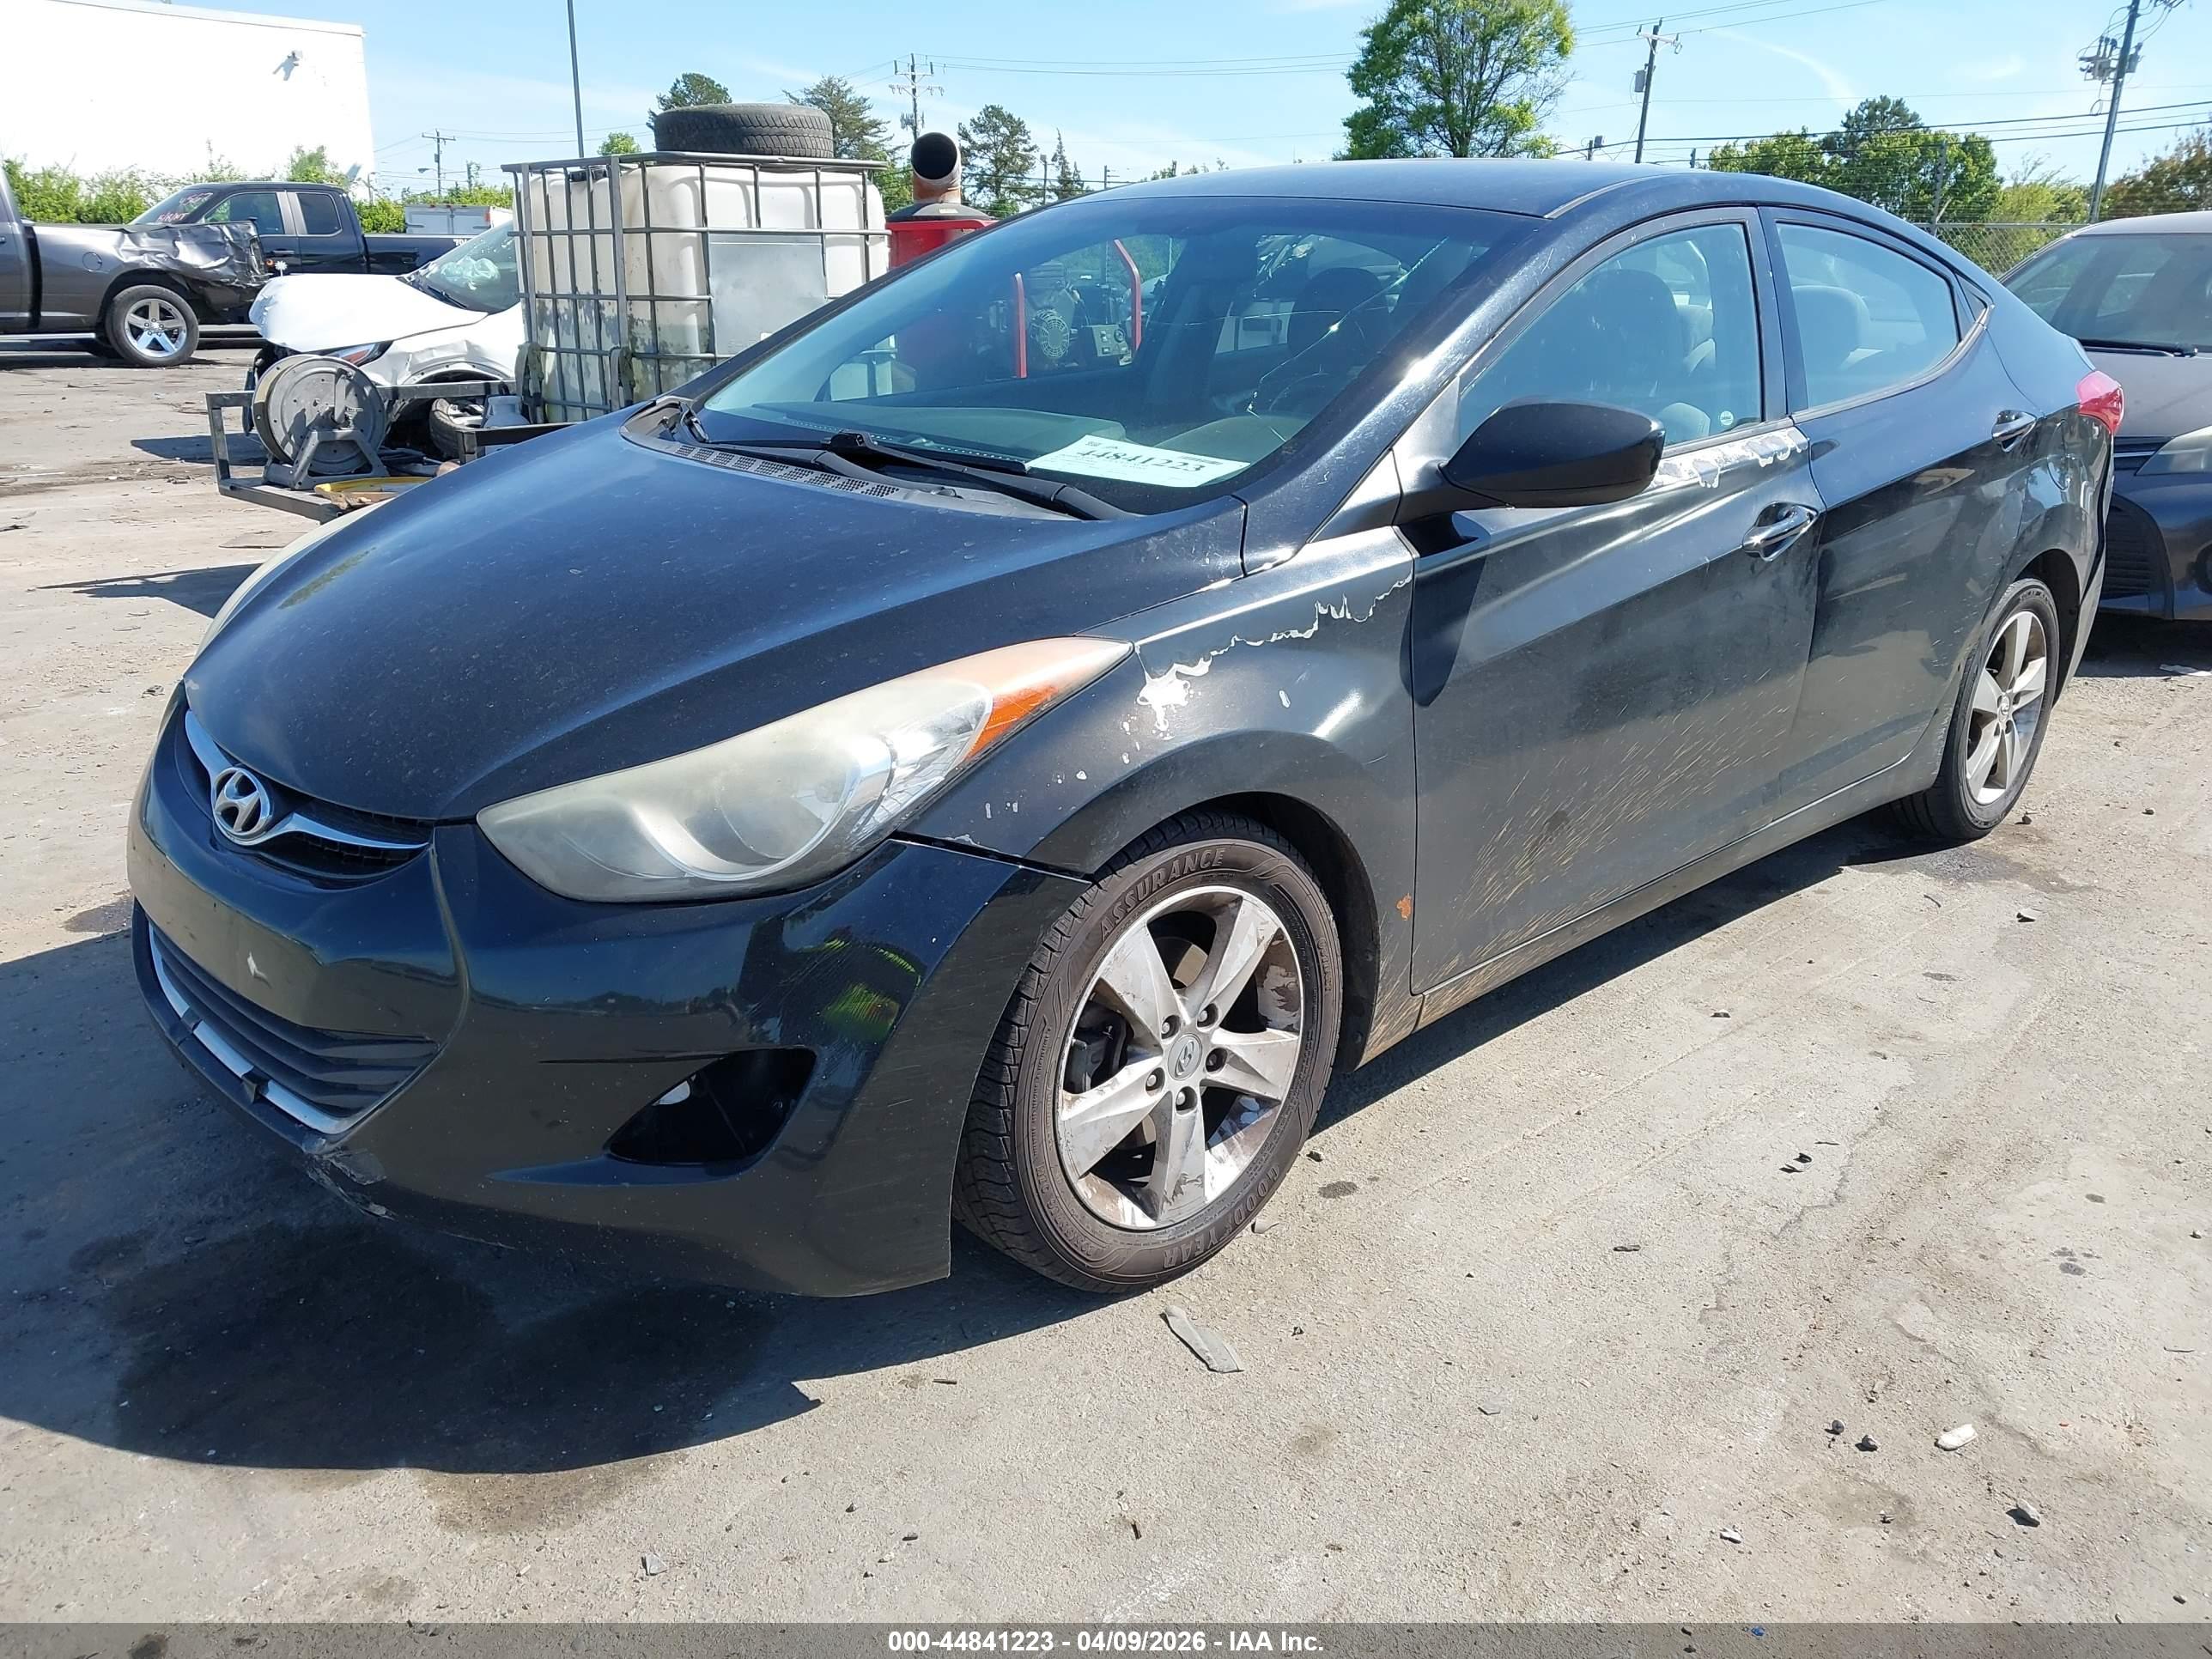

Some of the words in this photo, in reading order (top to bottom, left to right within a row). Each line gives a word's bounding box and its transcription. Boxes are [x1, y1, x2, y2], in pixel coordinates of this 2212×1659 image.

[1077, 449, 1206, 471] 44841223
[1100, 848, 1226, 943] ASSURANCE
[1163, 1164, 1281, 1269] GOODYEAR
